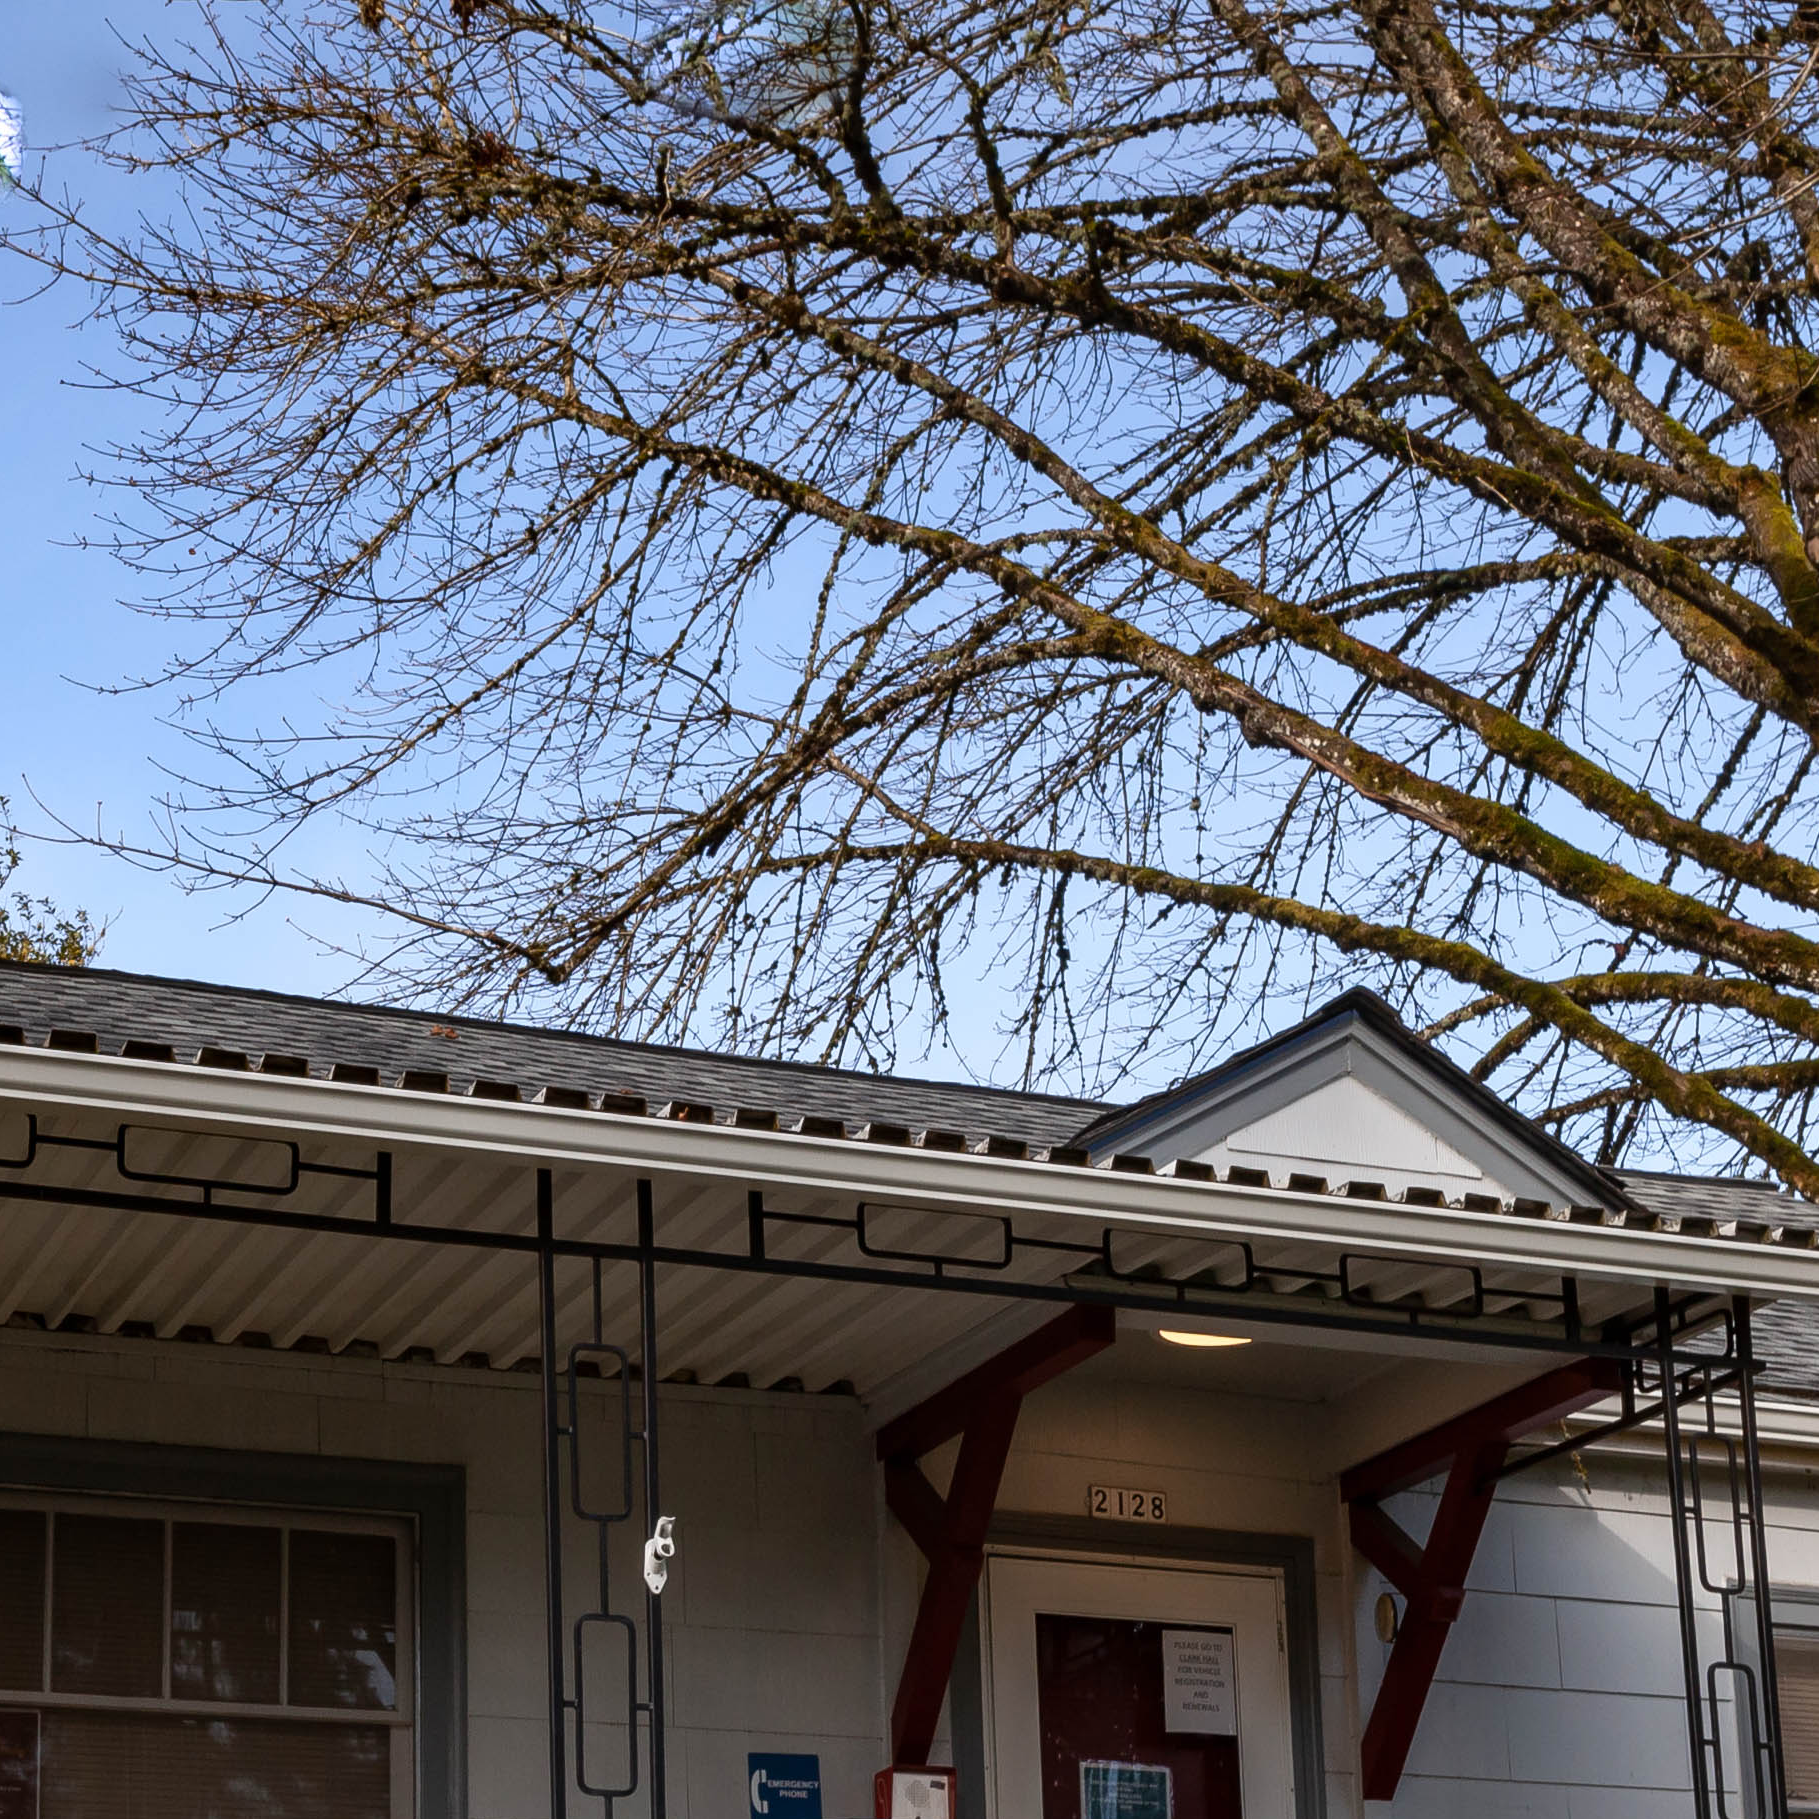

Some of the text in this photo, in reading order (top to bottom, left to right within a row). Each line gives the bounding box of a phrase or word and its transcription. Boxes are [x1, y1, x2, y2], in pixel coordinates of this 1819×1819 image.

[1094, 1489, 1164, 1519] 2128
[1174, 1641, 1199, 1651] PLEASE
[1174, 1678, 1225, 1688] REGISTRATION
[767, 1780, 819, 1789] EMERGENCY
[779, 1790, 808, 1798] PHONE
